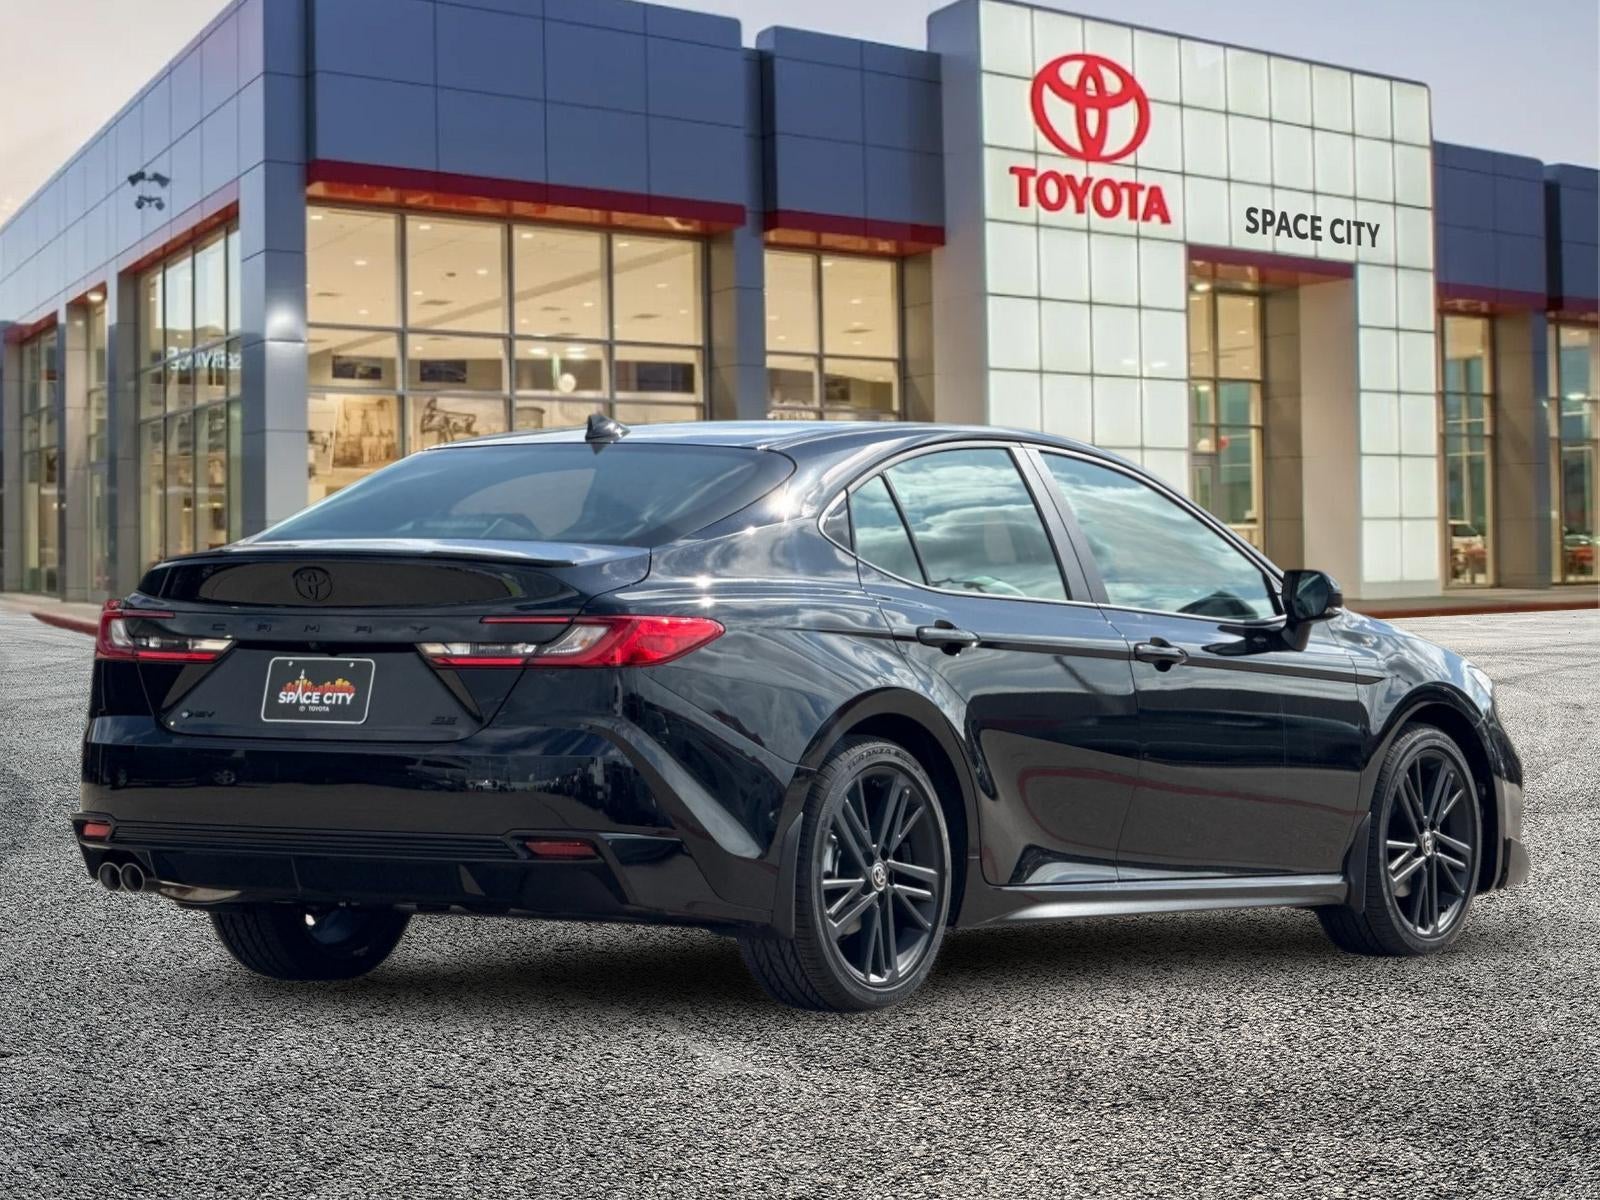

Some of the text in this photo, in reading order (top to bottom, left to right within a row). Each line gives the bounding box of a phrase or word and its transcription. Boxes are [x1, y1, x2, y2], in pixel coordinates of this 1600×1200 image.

[1009, 166, 1171, 224] TOYOTA
[1245, 207, 1380, 248] SPACE CITY
[278, 691, 354, 704] SPACE CITY
